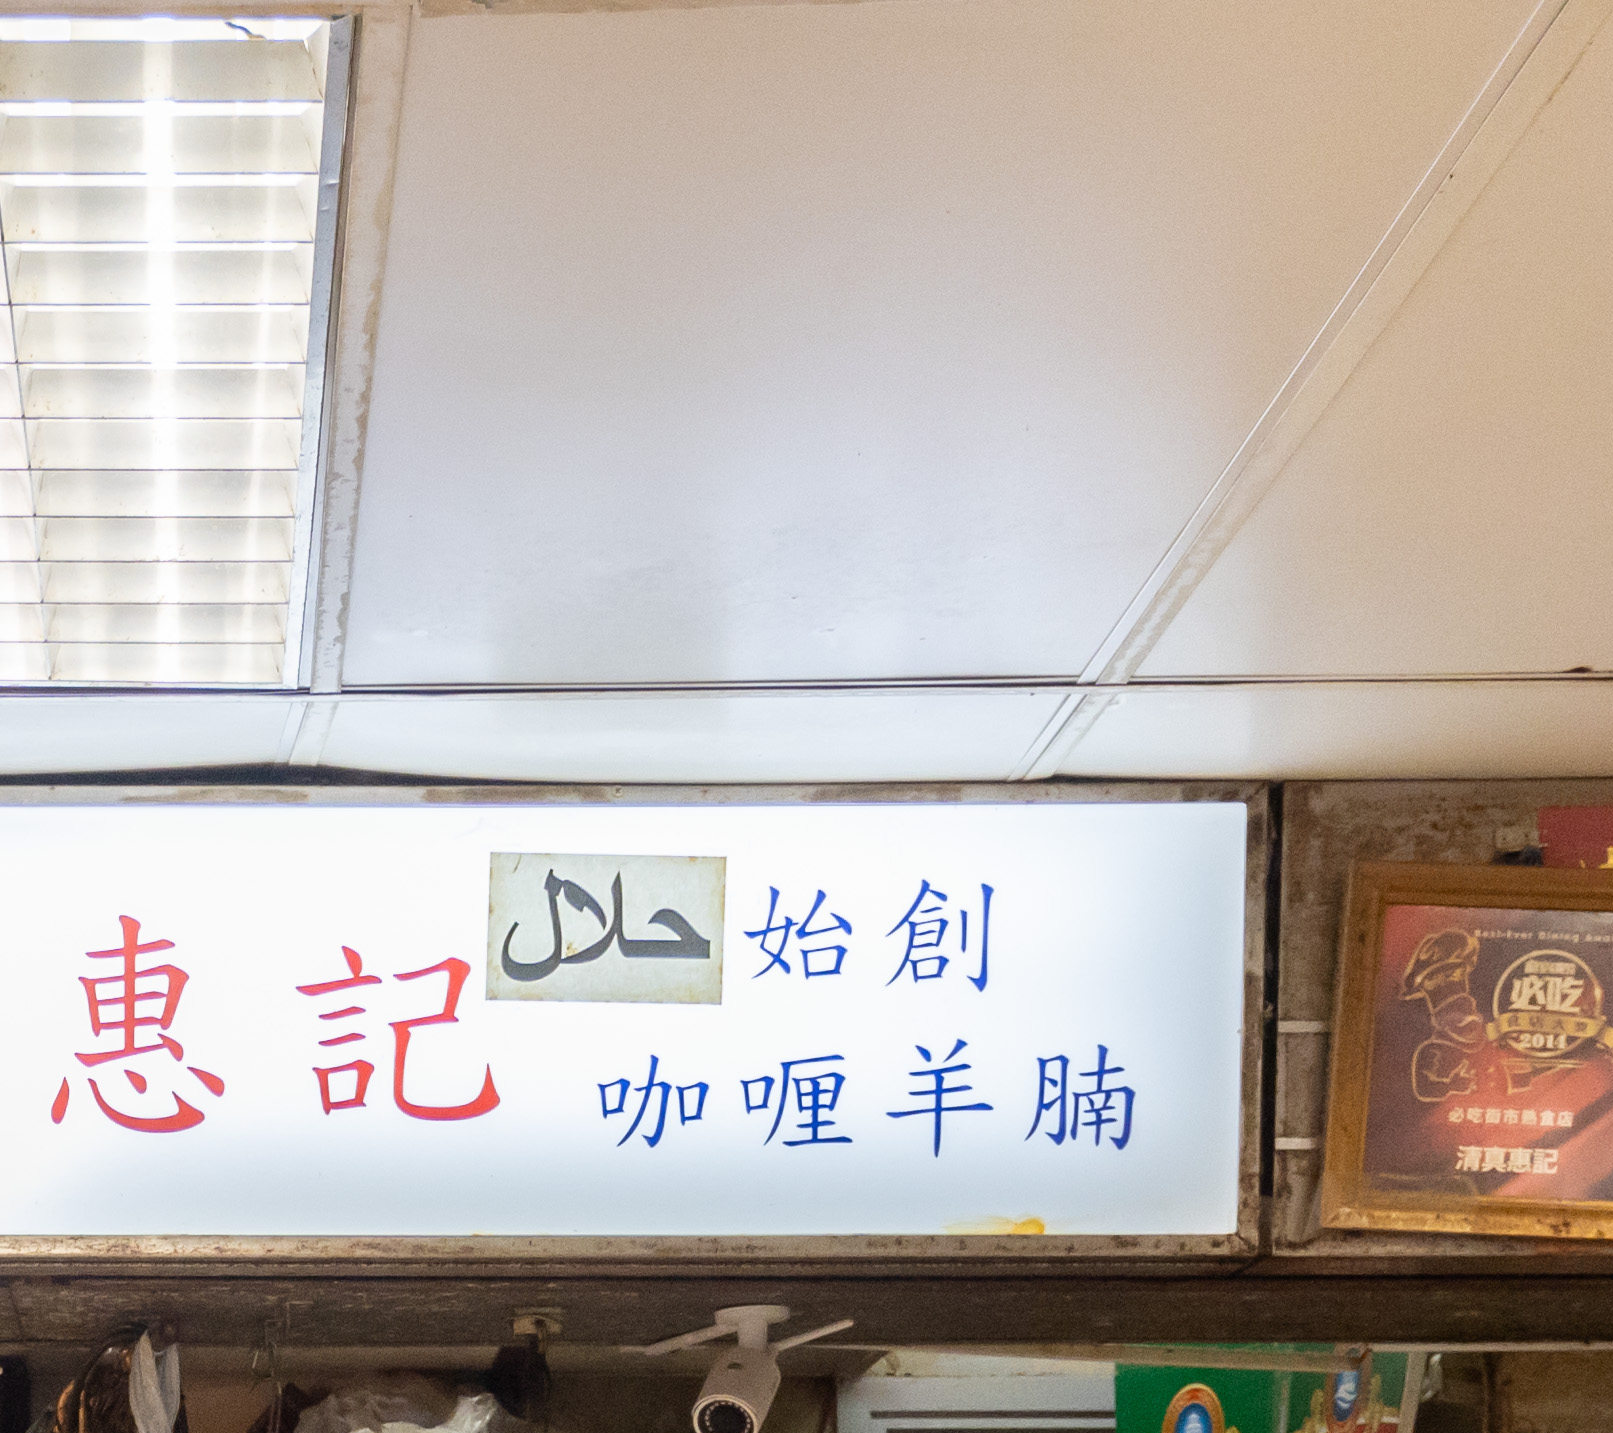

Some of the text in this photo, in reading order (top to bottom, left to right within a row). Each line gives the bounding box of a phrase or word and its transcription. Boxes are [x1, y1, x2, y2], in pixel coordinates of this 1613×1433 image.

[501, 868, 710, 982] حلال
[743, 879, 992, 992] 始創
[597, 1039, 1136, 1157] 咖喱羊腩
[1455, 1145, 1558, 1174] 清真惠記
